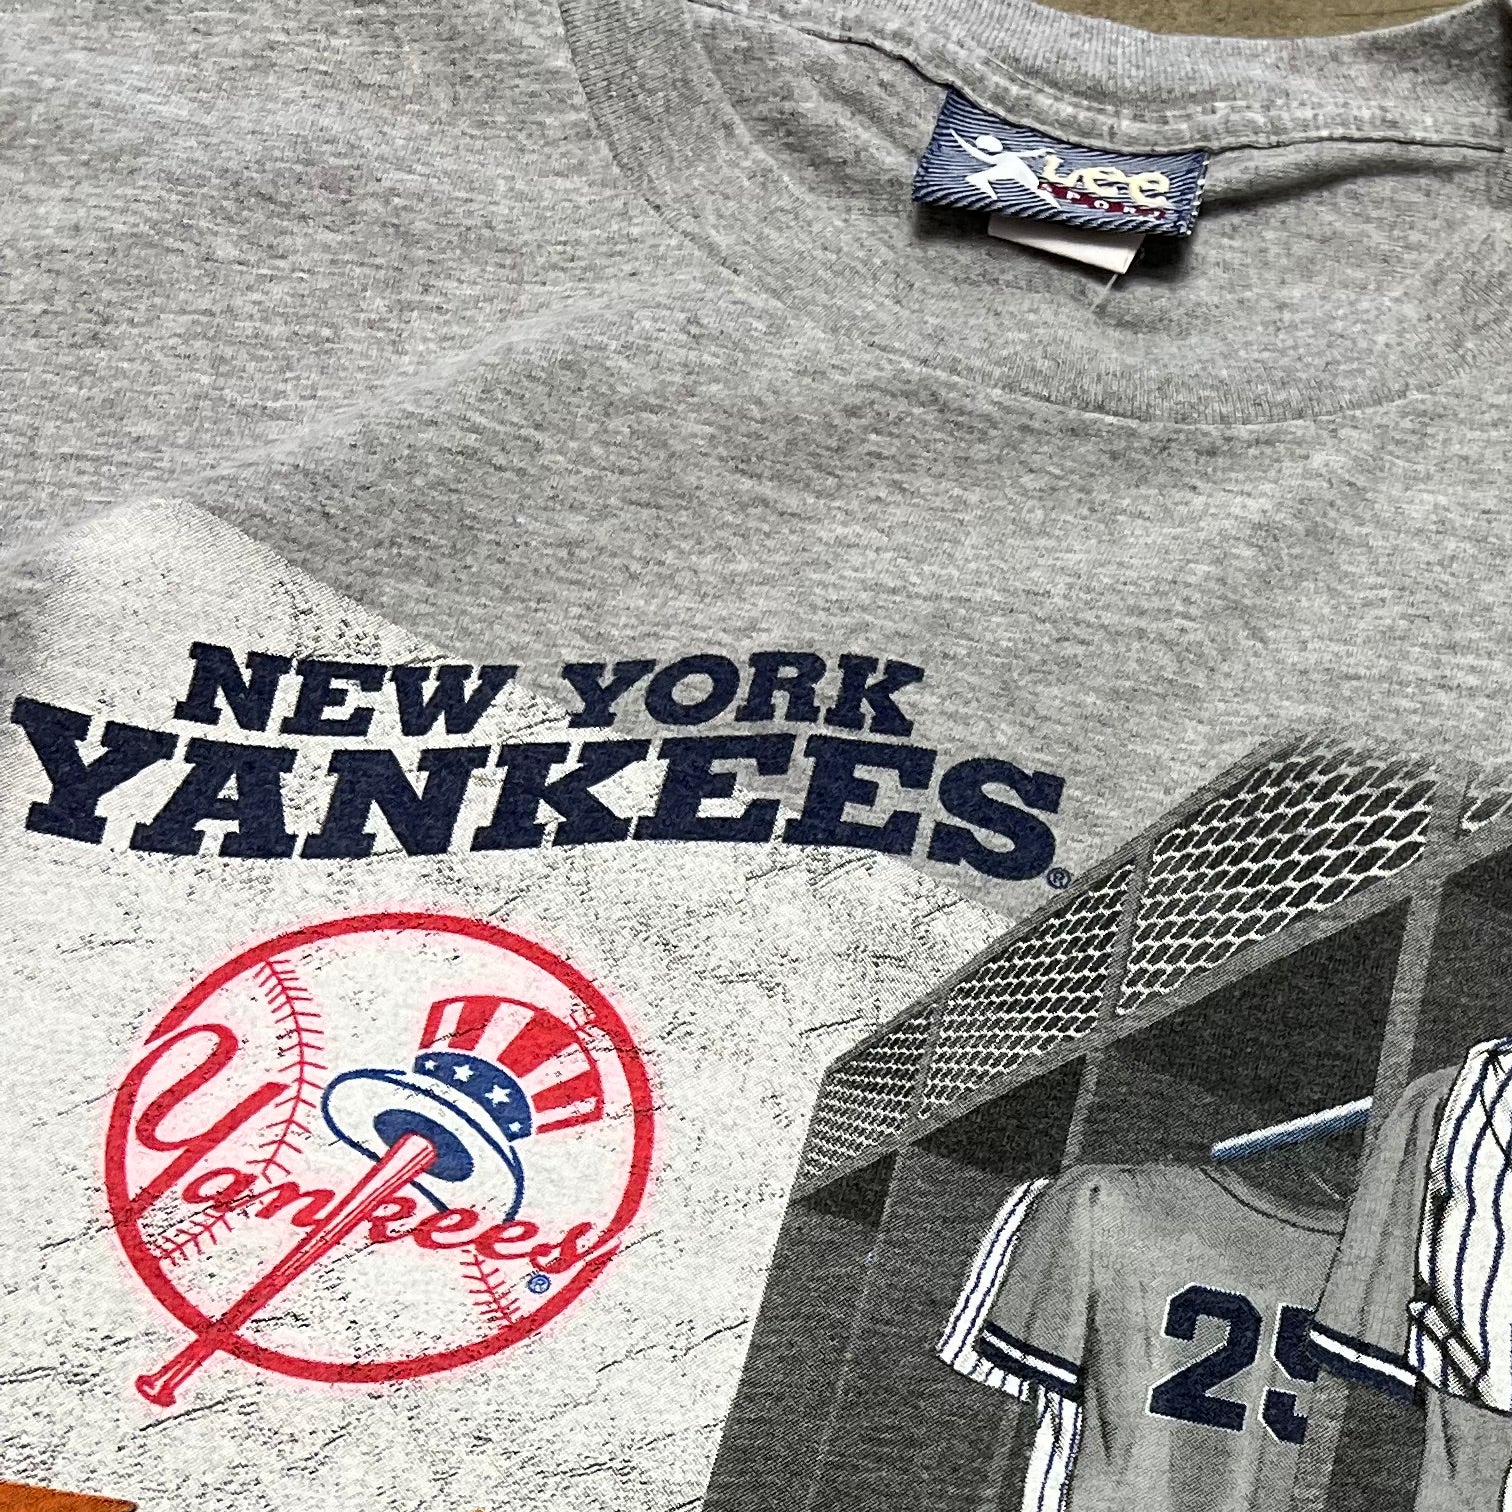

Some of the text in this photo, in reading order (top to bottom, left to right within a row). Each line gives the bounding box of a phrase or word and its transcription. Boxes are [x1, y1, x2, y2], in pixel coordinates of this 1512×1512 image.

[1043, 154, 1172, 211] Lee
[175, 640, 924, 737] NEW YORK
